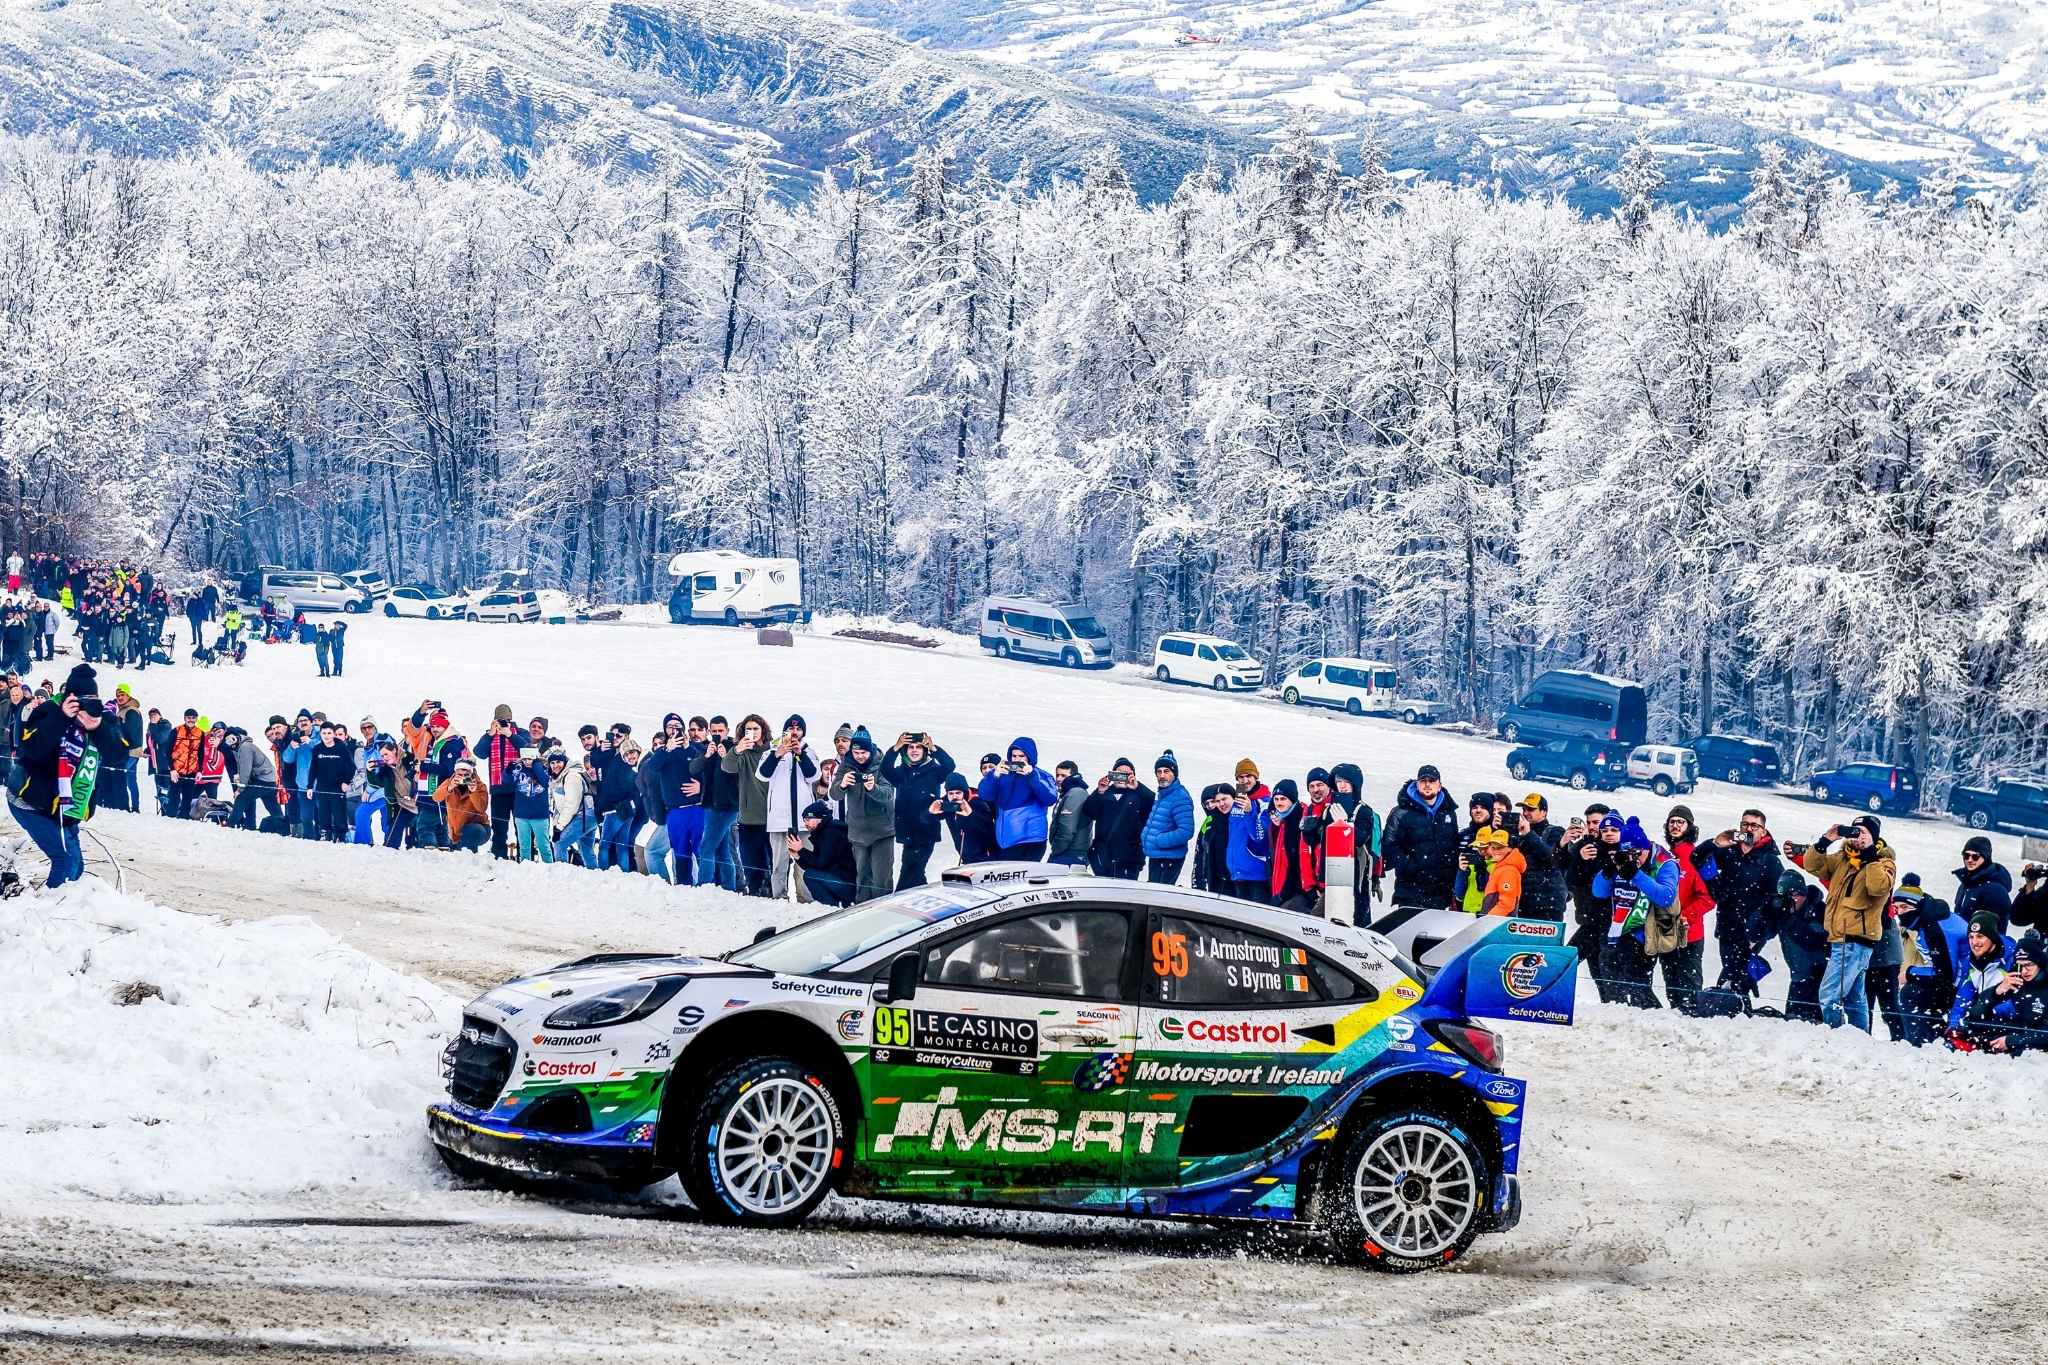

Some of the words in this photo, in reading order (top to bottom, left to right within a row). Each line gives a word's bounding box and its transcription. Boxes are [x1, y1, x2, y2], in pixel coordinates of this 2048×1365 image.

[991, 870, 1028, 882] MS-RT
[1518, 923, 1556, 936] Castrol
[1152, 931, 1189, 978] 95
[1195, 937, 1204, 957] J
[1210, 937, 1280, 968] Armstrong
[1227, 965, 1239, 987] S
[1242, 966, 1281, 993] Byrne
[772, 980, 863, 997] SafetyCulture
[1396, 988, 1416, 998] BELL
[1077, 1010, 1108, 1020] SEACON
[1108, 1013, 1120, 1021] UK
[1508, 1007, 1569, 1020] SafetyCulture
[876, 1007, 910, 1046] 95
[917, 1013, 939, 1032] LE
[944, 1016, 1034, 1041] CASINO
[1187, 1019, 1287, 1043] Castrol
[875, 1050, 890, 1060] SC
[916, 1052, 993, 1069] SafetyCulture
[538, 1060, 596, 1077] Castrol
[1020, 1062, 1034, 1072] SC
[1135, 1060, 1264, 1086] Motorsport
[1266, 1065, 1347, 1086] Ireland
[929, 1107, 1177, 1154] MS-RT
